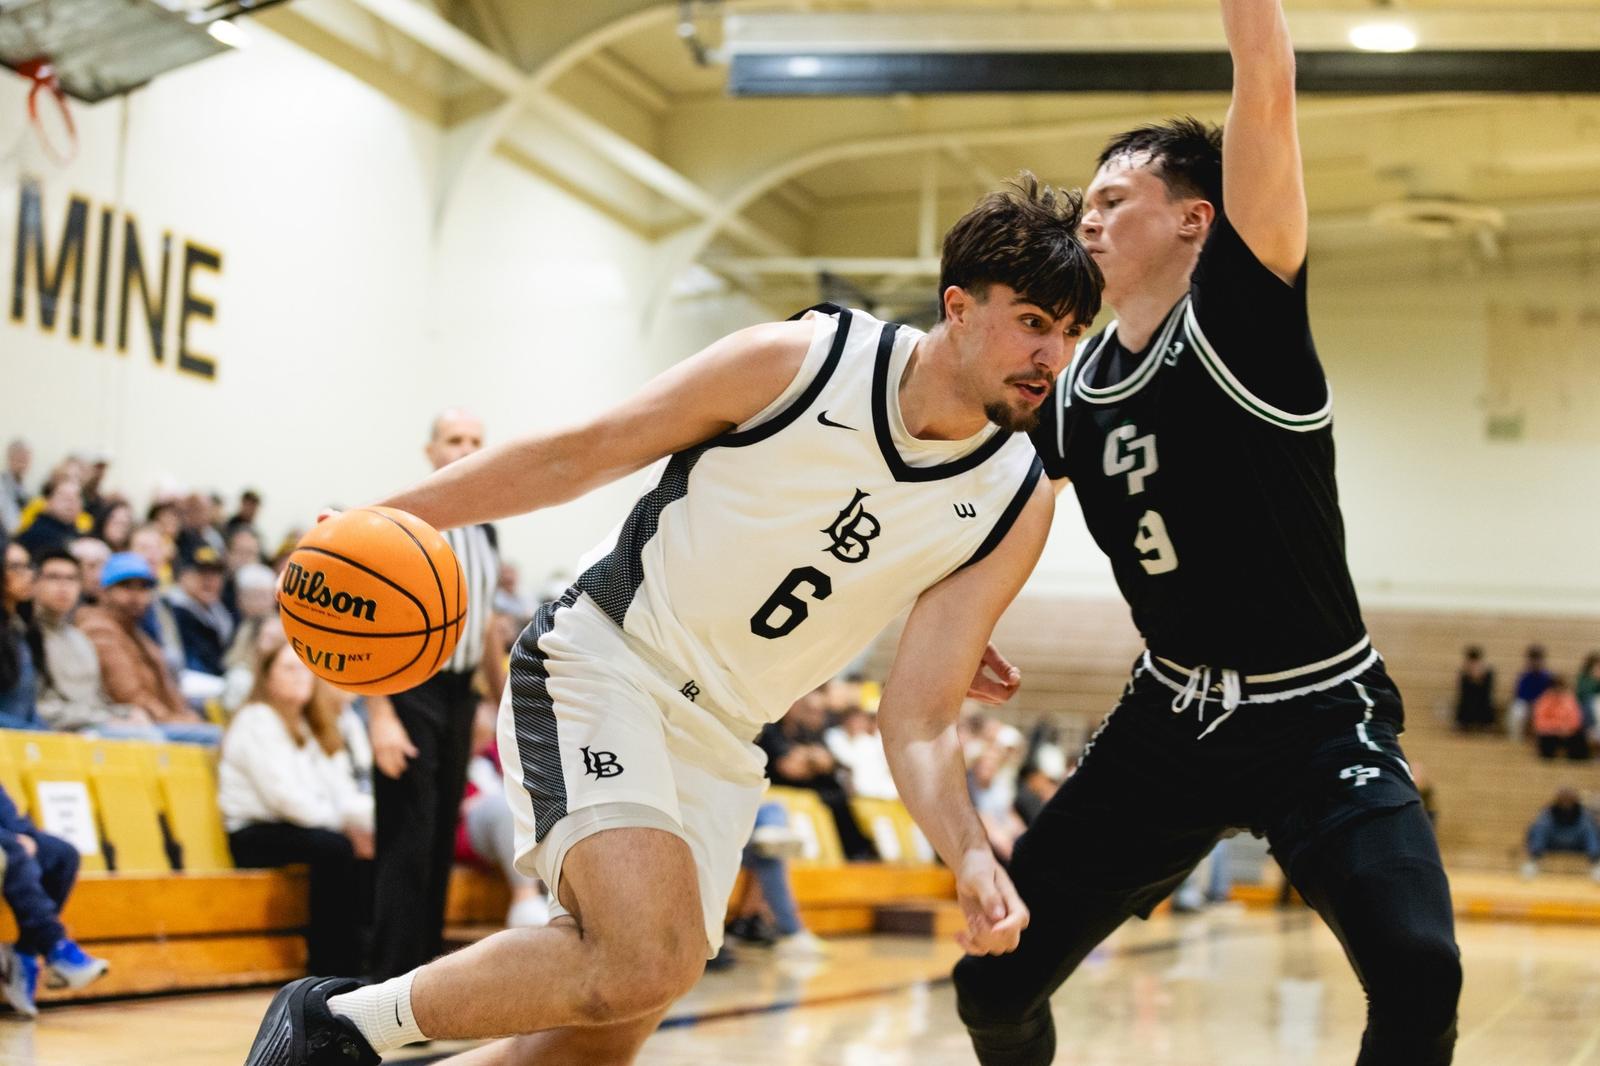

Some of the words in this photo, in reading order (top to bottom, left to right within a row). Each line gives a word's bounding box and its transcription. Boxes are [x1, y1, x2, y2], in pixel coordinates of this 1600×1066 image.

[10, 176, 223, 381] MINE
[1102, 423, 1160, 496] CP
[819, 487, 882, 564] LB
[1133, 509, 1180, 575] 9
[283, 562, 377, 622] Wilson
[750, 565, 833, 640] 6
[348, 652, 372, 662] NXT
[579, 745, 625, 781] LB
[1338, 763, 1381, 787] CP
